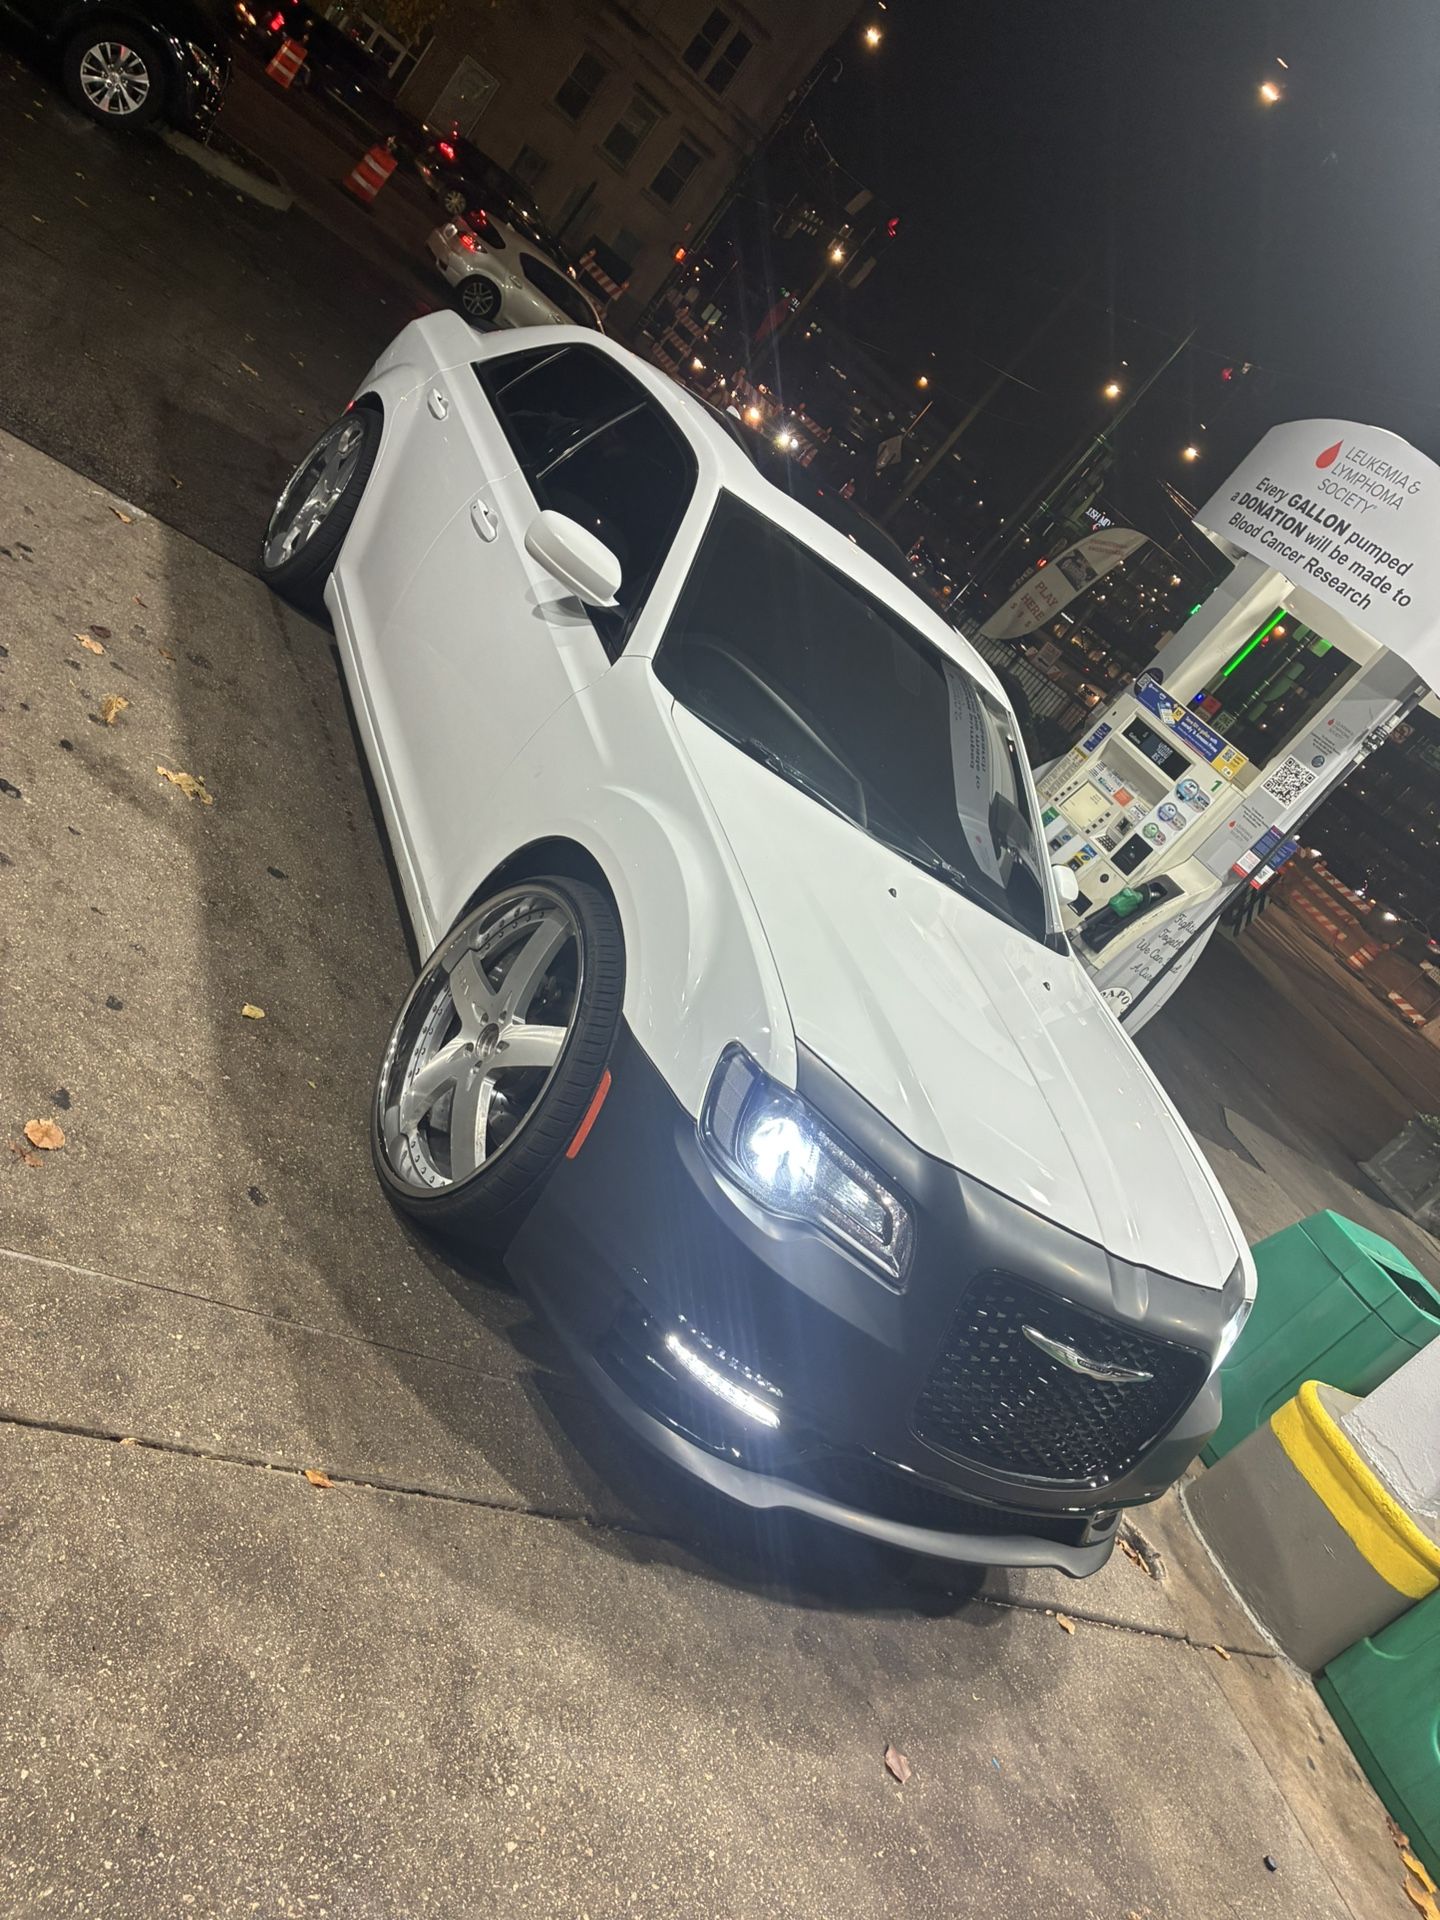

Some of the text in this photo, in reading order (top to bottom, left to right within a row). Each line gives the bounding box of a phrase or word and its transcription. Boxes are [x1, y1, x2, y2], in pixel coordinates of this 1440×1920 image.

[1331, 462, 1405, 511] LYMPHOMA
[1345, 446, 1422, 495] LEUKEMIA &
[1317, 478, 1375, 514] SOCIETY
[1256, 477, 1414, 576] Every GALLON pumped
[1228, 512, 1372, 610] Blood Cancer Research
[1230, 491, 1412, 607] a DONATION will be made to
[1021, 593, 1045, 621] HERE
[1035, 580, 1058, 607] PLAY
[1210, 780, 1223, 792] 1
[1136, 938, 1165, 964] We Can
[1158, 928, 1184, 950] Togeth
